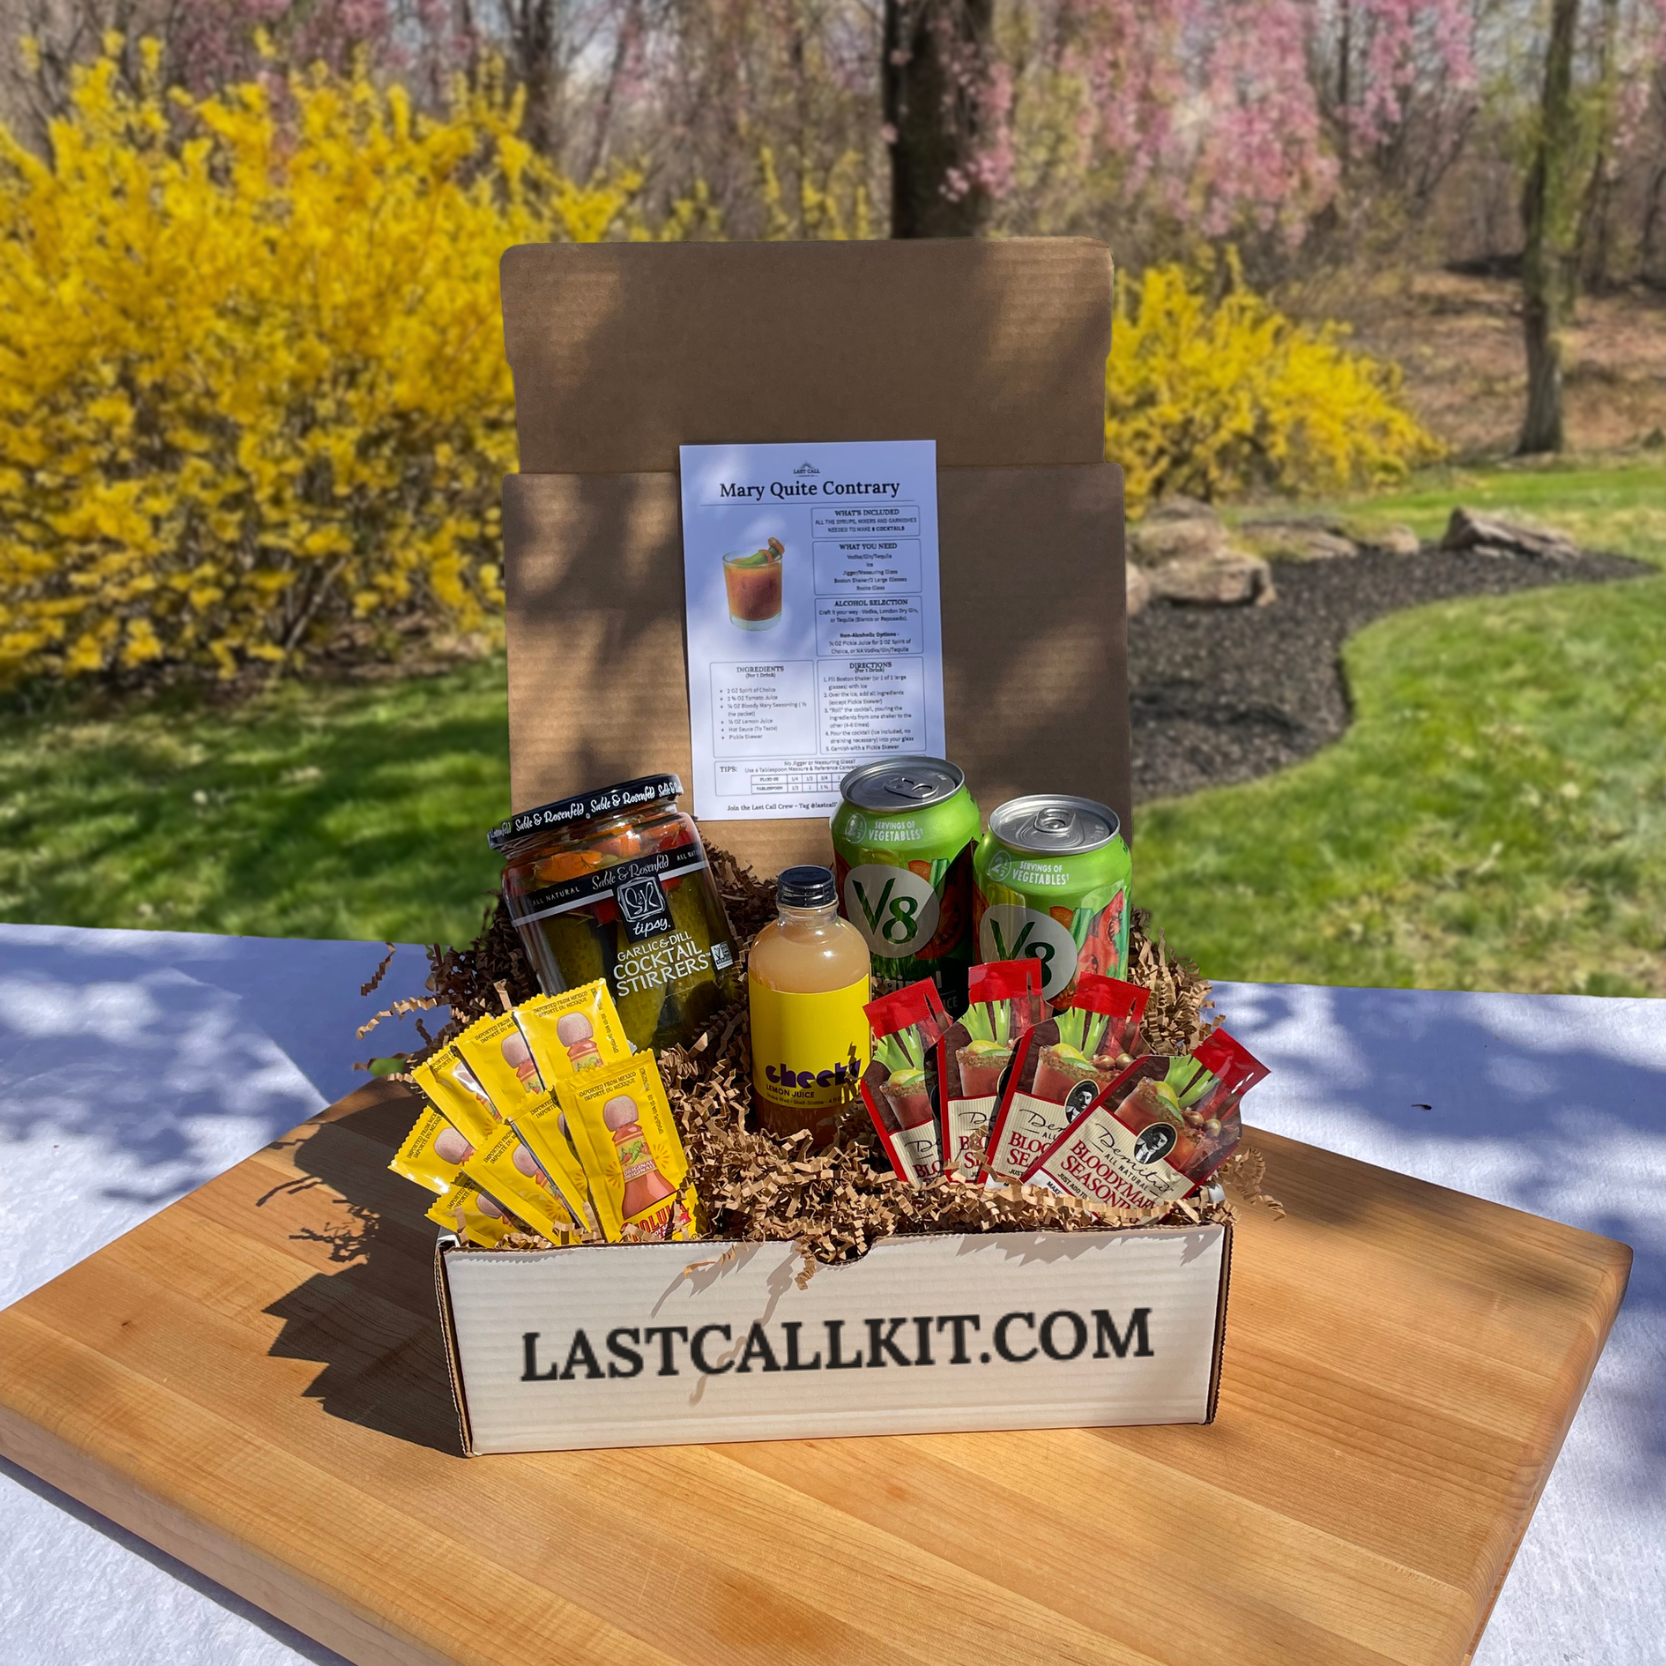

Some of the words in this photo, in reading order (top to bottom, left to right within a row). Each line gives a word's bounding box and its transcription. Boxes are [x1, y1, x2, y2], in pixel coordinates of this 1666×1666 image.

[720, 483, 765, 501] Mary
[770, 481, 817, 499] Quite
[823, 481, 900, 497] Contrary
[515, 816, 532, 832] Sable
[533, 814, 542, 825] &
[544, 803, 585, 823] Rosenfeld
[591, 797, 610, 813] Sable
[612, 795, 620, 806] &
[622, 786, 655, 804] Rosenfeld
[874, 821, 905, 829] SERVINGS
[907, 821, 915, 829] OF
[592, 870, 616, 890] Sable
[617, 866, 628, 880] &
[1020, 861, 1051, 873] SERVINGS
[1053, 863, 1062, 872] OF
[546, 886, 580, 902] NATURAL
[852, 877, 918, 945] V8
[614, 941, 702, 979] COCKTAIL
[533, 1002, 556, 1013] IMPORTED
[557, 998, 570, 1006] FROM
[571, 991, 588, 1000] MEXICO
[579, 1084, 603, 1097] IMPORTED
[604, 1078, 617, 1087] FROM
[618, 1072, 636, 1082] MEXICO
[614, 1078, 636, 1090] MEXIQUE
[766, 1084, 789, 1097] LEMON
[1058, 1173, 1072, 1186] JUST
[1070, 1182, 1080, 1193] ADD
[1104, 1154, 1116, 1166] ALL
[1118, 1166, 1148, 1191] NATURAL
[520, 1308, 1155, 1381] LASTCALLKIT.COM
